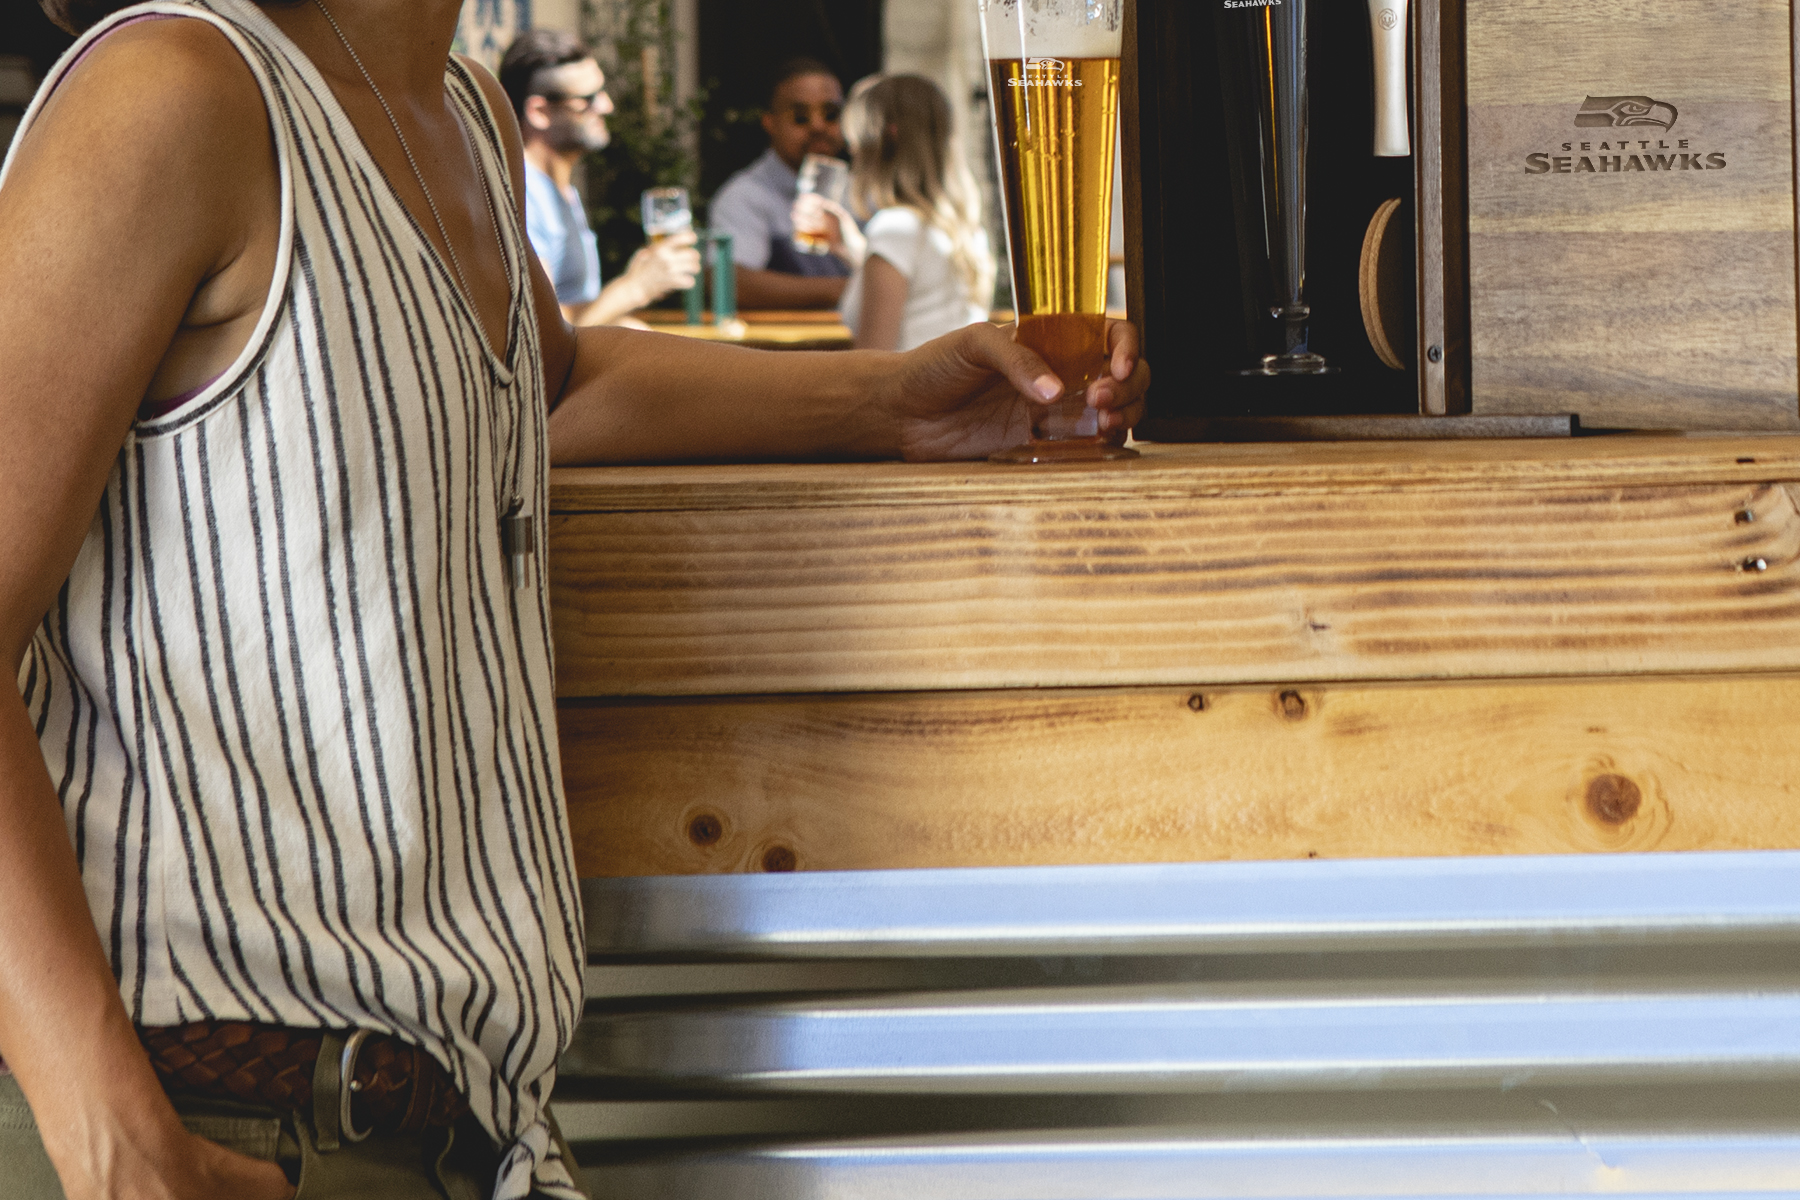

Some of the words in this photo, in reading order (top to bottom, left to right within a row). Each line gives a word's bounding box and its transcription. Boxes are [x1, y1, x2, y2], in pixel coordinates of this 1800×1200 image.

[1007, 77, 1083, 87] SEAHAWKS
[1561, 139, 1690, 151] SEATTLE
[1524, 152, 1728, 175] SEAHAWKS
